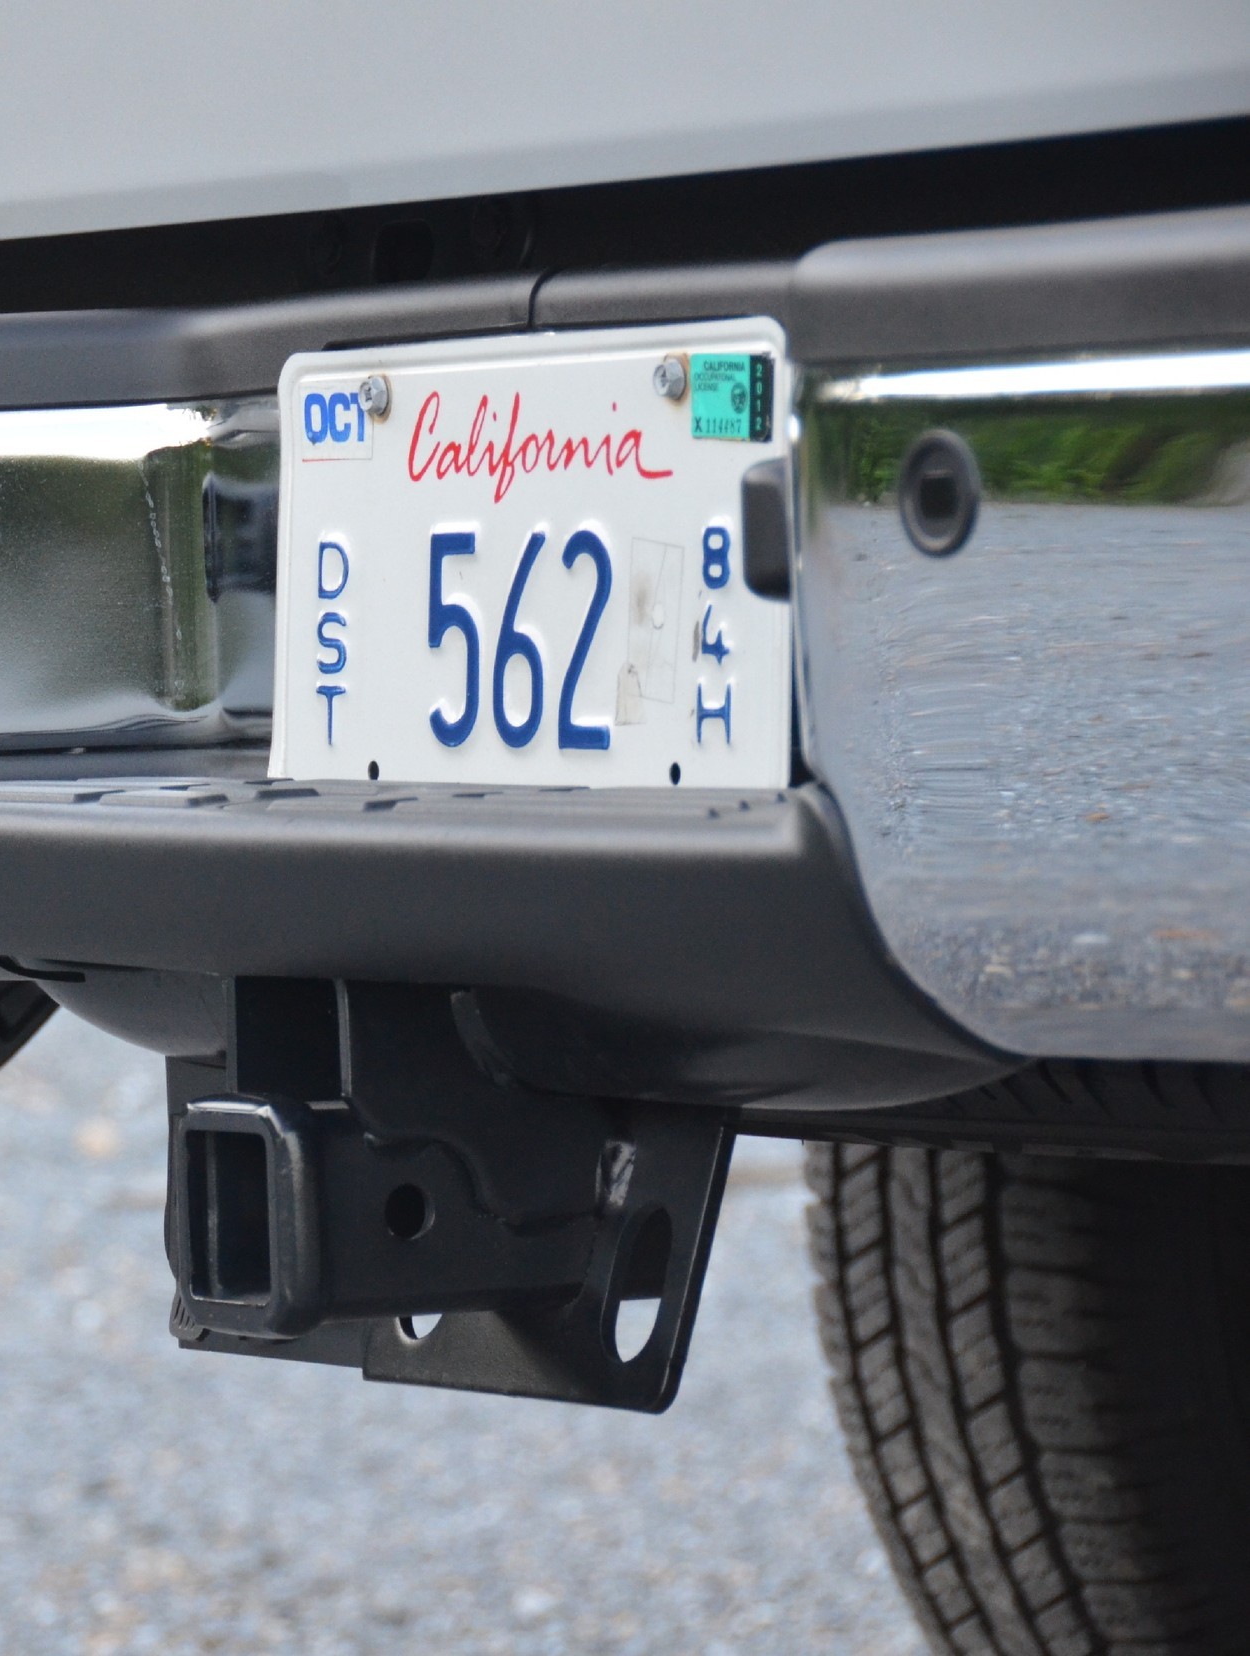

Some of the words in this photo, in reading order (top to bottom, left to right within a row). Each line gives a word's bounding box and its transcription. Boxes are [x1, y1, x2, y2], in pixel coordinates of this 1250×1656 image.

[703, 360, 746, 372] CALIFORNIA
[304, 392, 365, 444] OCT
[694, 416, 703, 433] X
[755, 363, 763, 431] 2012
[408, 391, 673, 503] California
[429, 530, 613, 750] 562
